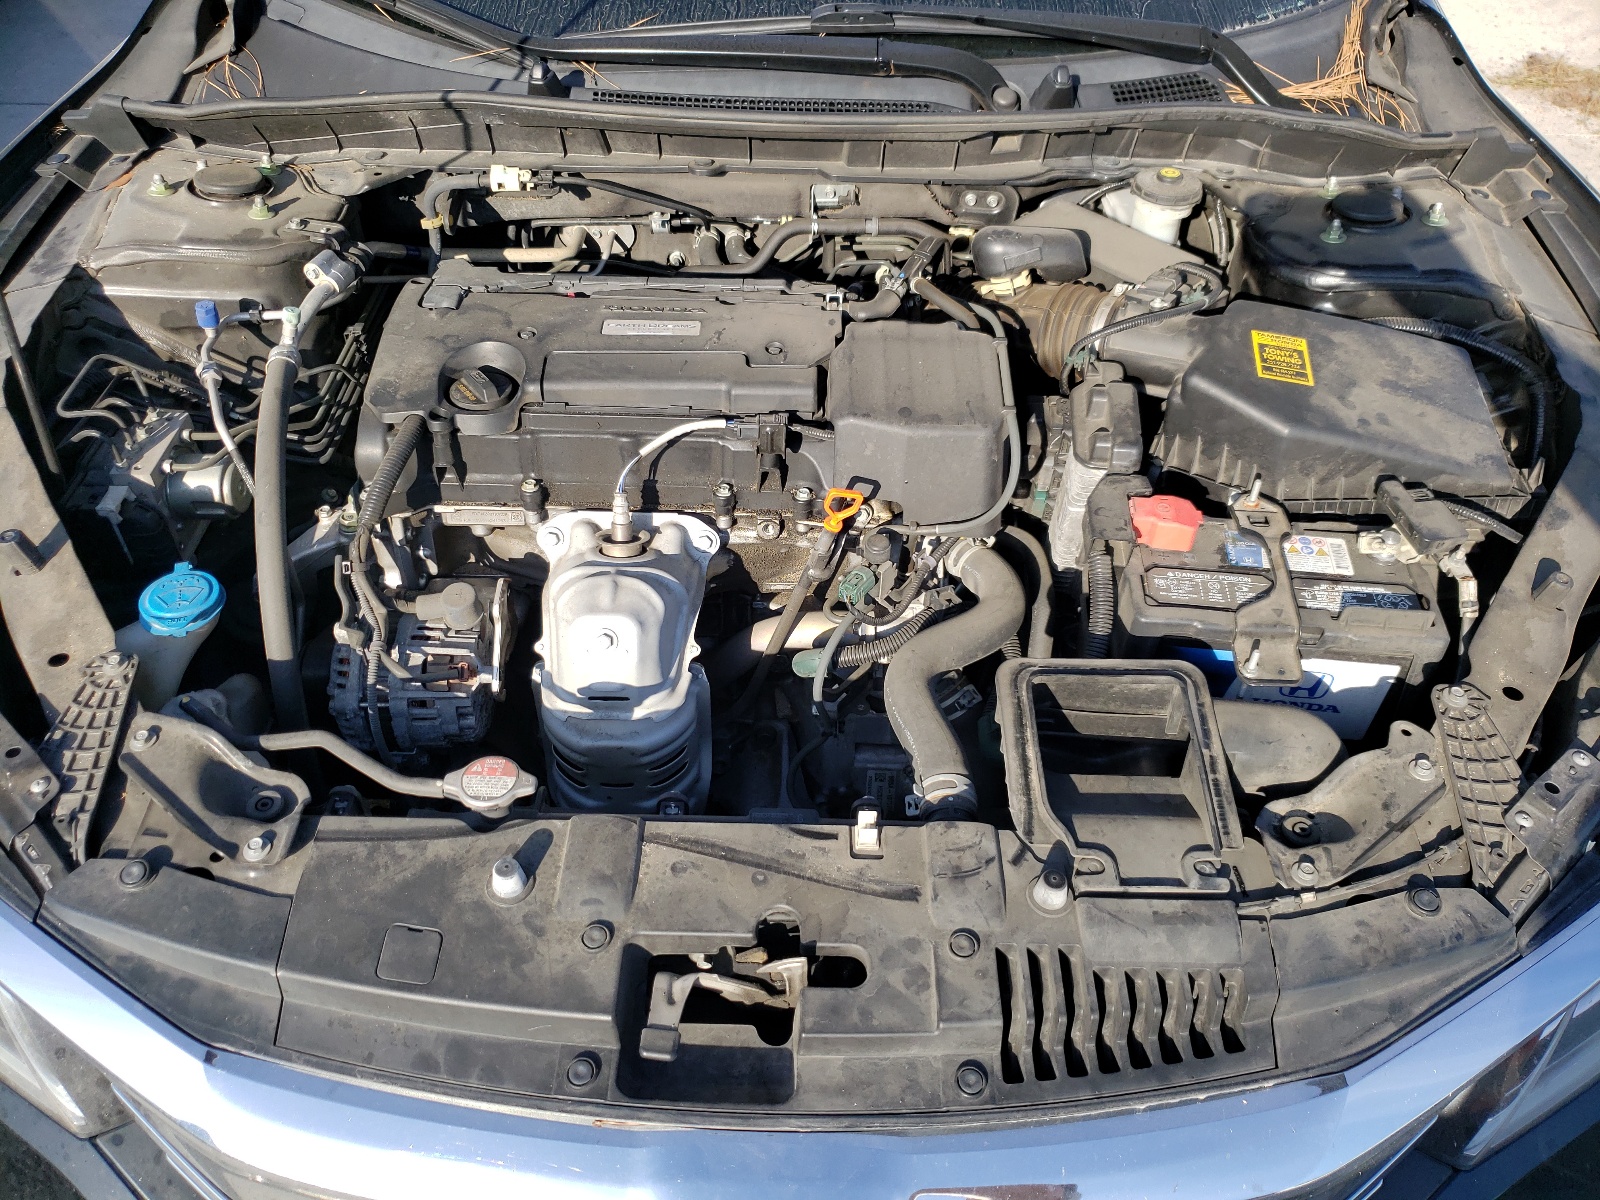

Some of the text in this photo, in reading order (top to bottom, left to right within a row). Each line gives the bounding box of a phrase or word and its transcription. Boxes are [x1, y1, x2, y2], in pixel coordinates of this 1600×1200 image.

[602, 304, 708, 313] HONDA
[1262, 352, 1303, 365] TOWING
[1263, 347, 1299, 359] TONY'S
[1175, 571, 1211, 580] DANGER
[1219, 575, 1252, 583] POISON
